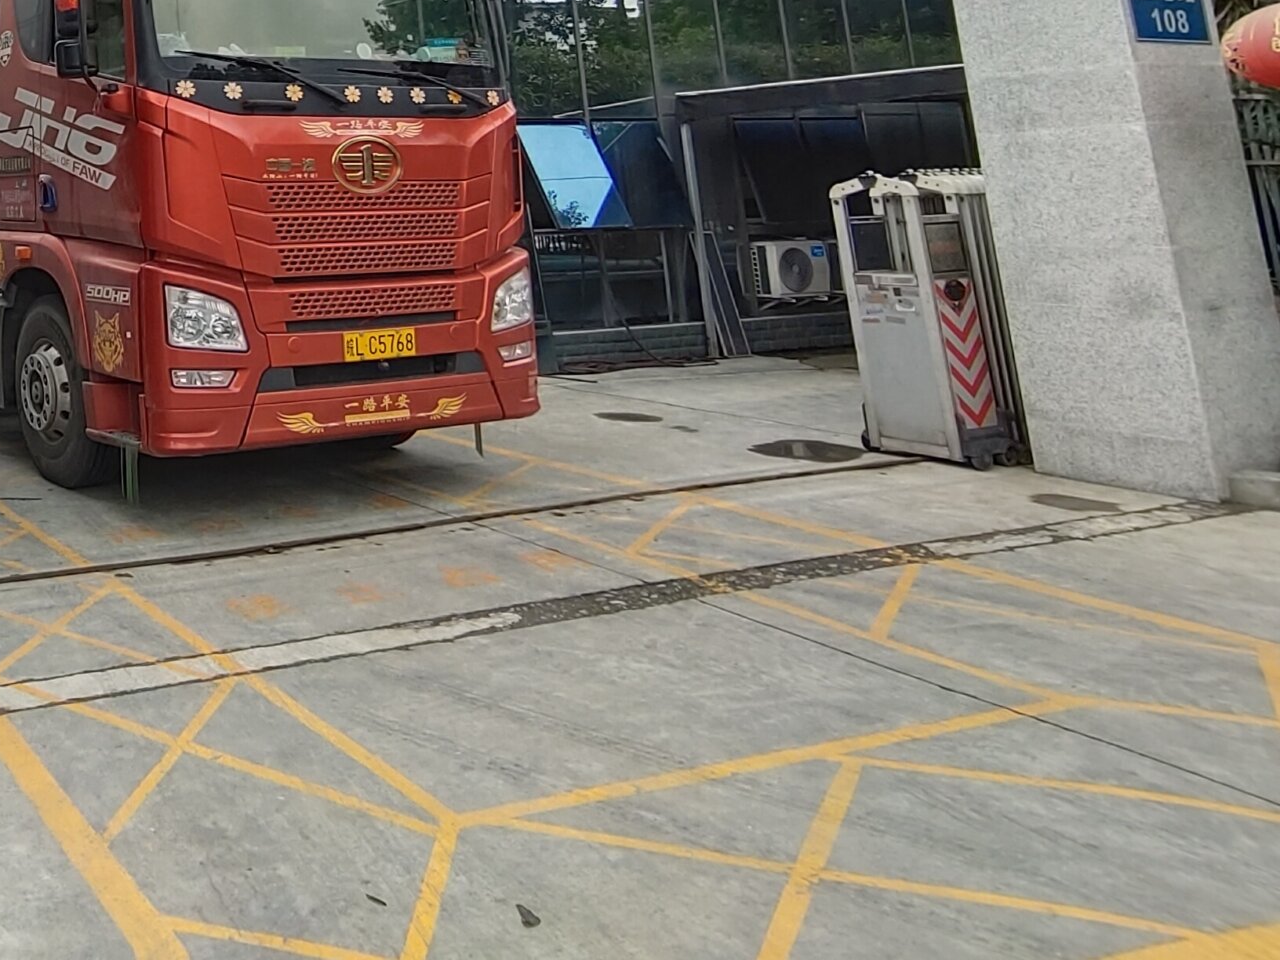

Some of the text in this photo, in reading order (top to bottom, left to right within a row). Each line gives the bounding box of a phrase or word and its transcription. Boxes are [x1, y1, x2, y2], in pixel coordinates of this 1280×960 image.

[1151, 7, 1190, 34] 108
[72, 161, 102, 184] FAW
[86, 286, 131, 302] 500HP
[344, 393, 410, 412] 一路平安
